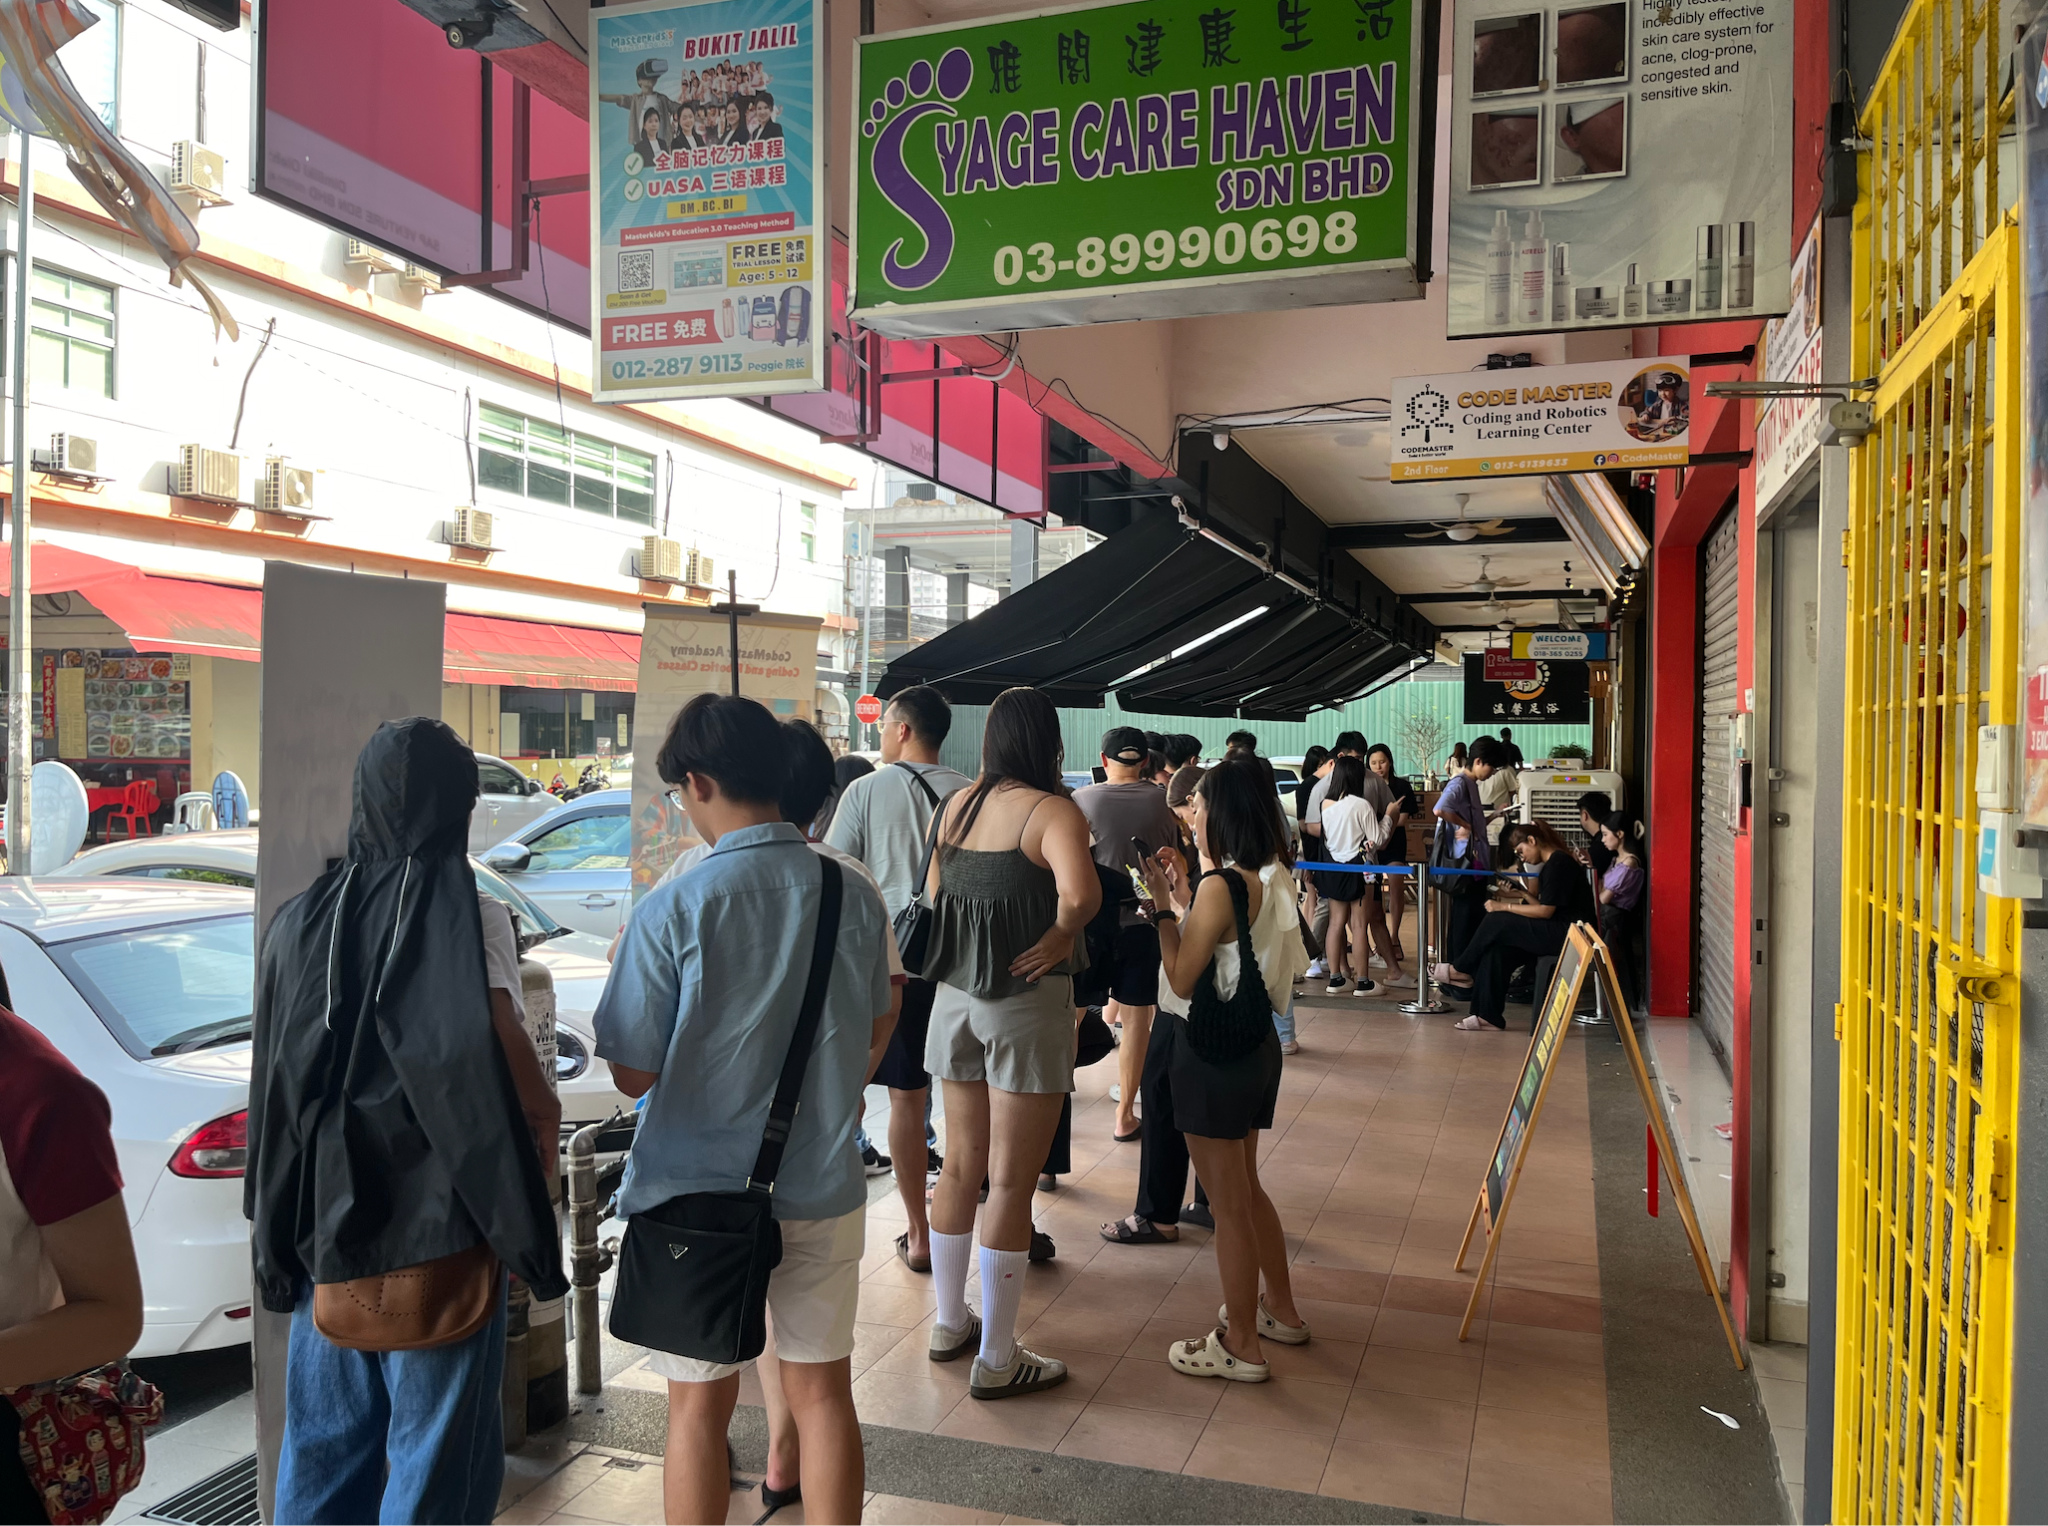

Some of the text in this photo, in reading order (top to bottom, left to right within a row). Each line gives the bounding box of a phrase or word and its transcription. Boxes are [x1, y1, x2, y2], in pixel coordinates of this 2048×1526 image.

[1642, 5, 1765, 29] incredibly effective
[685, 33, 743, 60] BUKIT
[748, 25, 797, 51] JALIL
[1642, 22, 1774, 47] skin care system for
[1641, 43, 1757, 65] acne, clog-prone,
[1641, 60, 1739, 84] congested and
[1641, 81, 1732, 102] sensitive skin.
[935, 61, 1397, 196] YAGE CARE HAVEN
[655, 139, 784, 171] 全脑记忆力课程
[649, 165, 785, 196] UASA 三语课程
[1215, 152, 1394, 214] SDN BHD
[680, 198, 734, 214] BM BC BI
[625, 217, 790, 241] Masterkids's Education 3.0 Teaching Method
[732, 242, 781, 260] FREE
[993, 210, 1359, 286] 03-89990698
[754, 258, 781, 266] LESSON
[739, 272, 765, 284] Age:
[768, 270, 775, 280] 5
[786, 268, 798, 278] 12
[612, 318, 707, 344] FREE 免费
[612, 356, 693, 380] 012-287
[700, 353, 743, 374] 9113
[747, 361, 783, 372] Peggie
[1457, 381, 1613, 409] CODE MASTER
[1462, 405, 1607, 426] Coding and Robotics
[1477, 422, 1592, 440] Learning Center
[1401, 445, 1454, 454] CODEMASTER
[1621, 452, 1683, 463] CodeMaster
[1403, 464, 1449, 476] 2nd Floor
[1535, 635, 1582, 643] WELCOME
